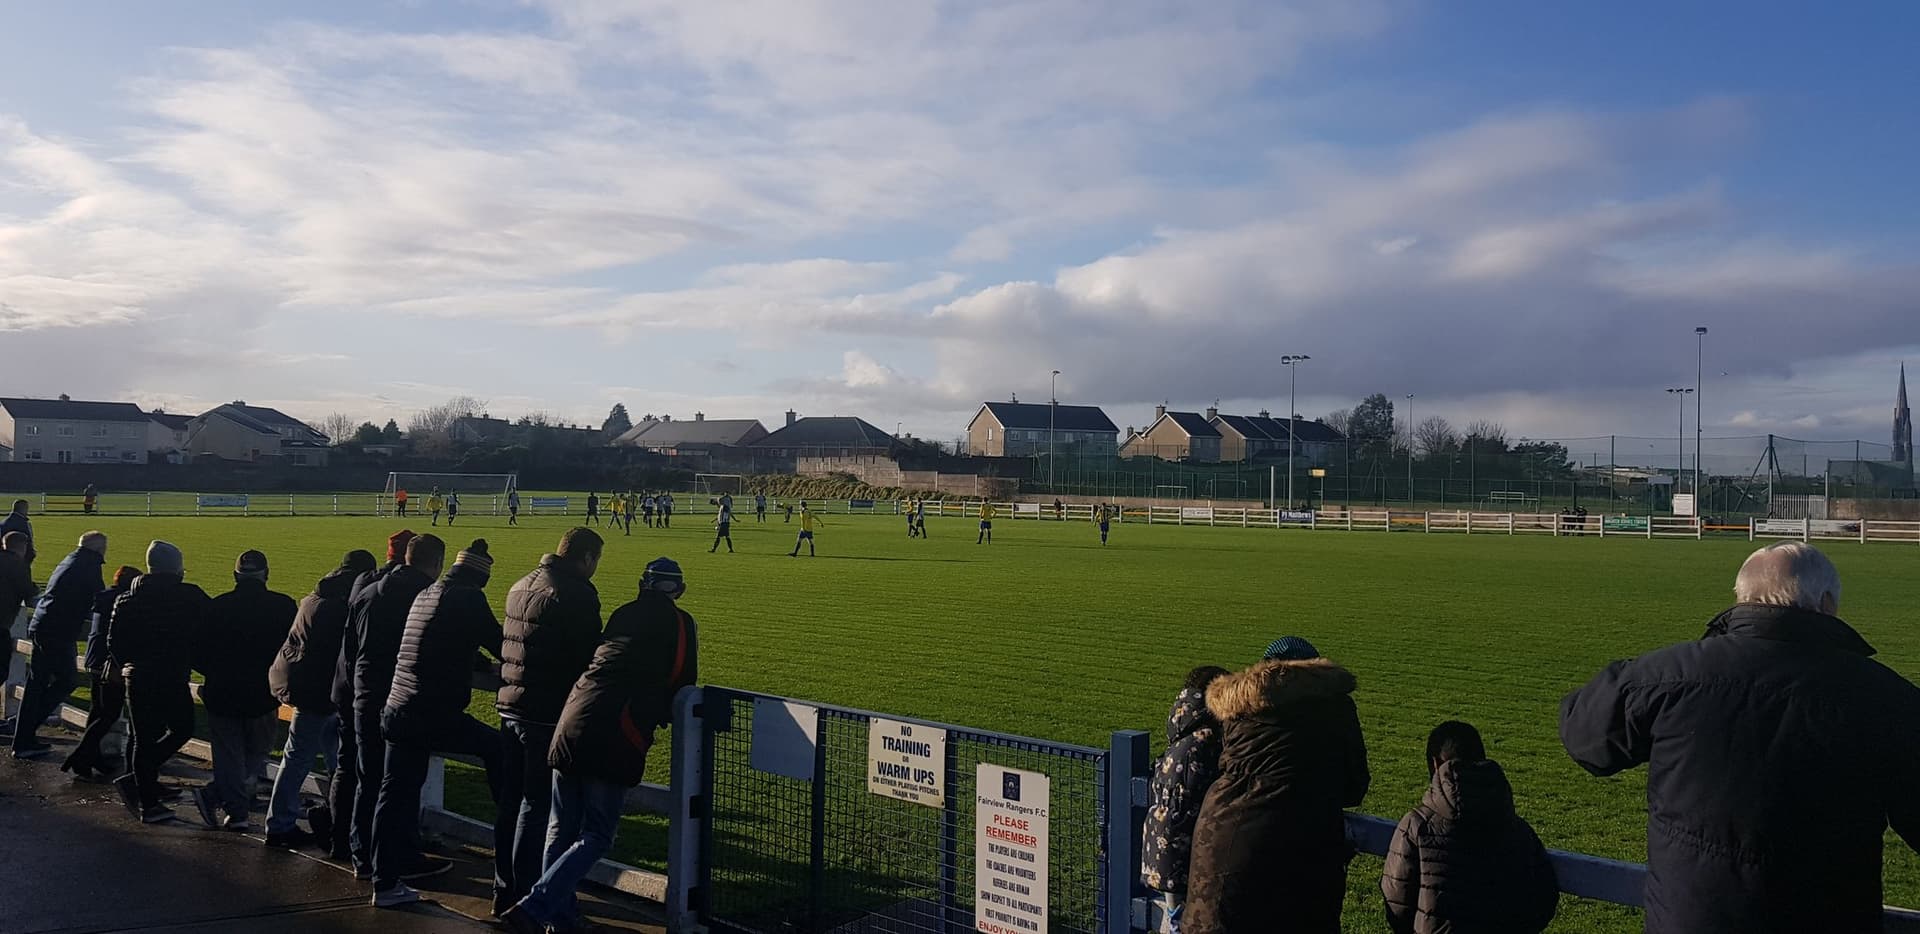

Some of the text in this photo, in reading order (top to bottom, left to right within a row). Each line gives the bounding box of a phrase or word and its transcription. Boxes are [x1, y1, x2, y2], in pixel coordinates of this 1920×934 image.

[901, 725, 912, 737] NO
[882, 736, 930, 758] TRAINING
[902, 755, 909, 763] OR
[877, 760, 934, 785] WARM UPS
[880, 777, 897, 787] EITHER
[898, 780, 918, 791] PLAYING
[919, 785, 940, 796] PITCHES
[892, 788, 919, 800] THANK YOU
[978, 795, 1048, 818] Fairview Rangers F.C.
[993, 814, 1029, 831] PLEASE
[985, 825, 1037, 847] REMEMBER
[995, 845, 1009, 856] PLAYERS
[1010, 848, 1018, 858] ARE
[1018, 850, 1035, 863] CHILDREN
[993, 861, 1007, 873] COACHES
[1015, 867, 1036, 880] VOLUNTEERS
[1016, 883, 1030, 896] HUMAN
[980, 890, 991, 901] SHOW
[991, 893, 1005, 905] RESPECT
[1006, 897, 1011, 907] TO
[1018, 901, 1042, 916] PARTICIPANTS
[978, 920, 1003, 934] ENJOY
[985, 908, 1038, 932] FIRST PRIORITY IS HAVING FUN
